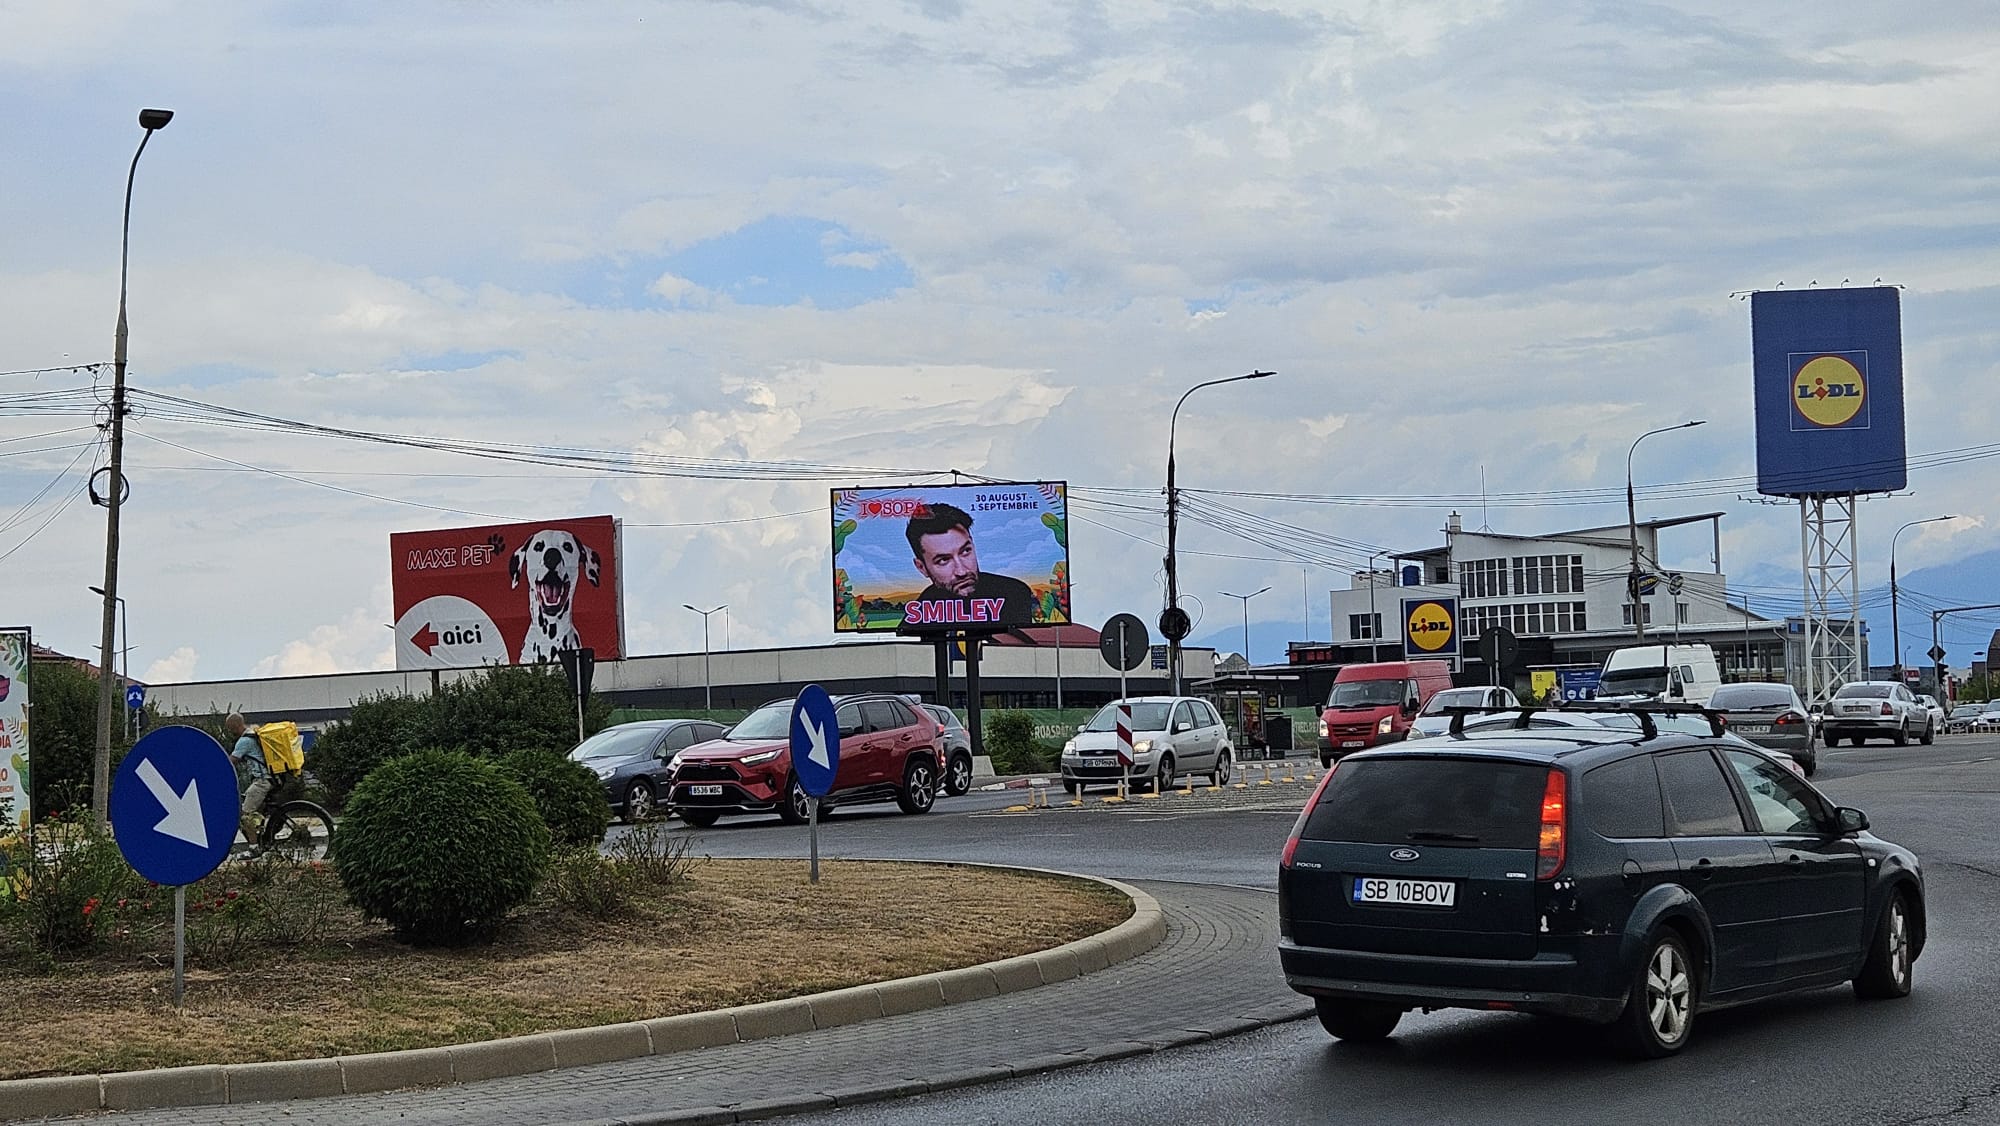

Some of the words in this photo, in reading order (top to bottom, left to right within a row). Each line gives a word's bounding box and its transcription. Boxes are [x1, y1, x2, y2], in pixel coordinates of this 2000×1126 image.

[975, 494, 986, 502] 30
[989, 493, 1027, 502] AUGUST
[978, 501, 1039, 511] SEPTEMBRIE
[882, 501, 931, 517] SOPA
[407, 547, 457, 570] MAXI
[461, 545, 495, 566] PET
[904, 598, 1005, 623] SMILEY
[442, 624, 482, 645] aici
[1365, 880, 1388, 899] SB
[1396, 881, 1450, 903] 10BOV
